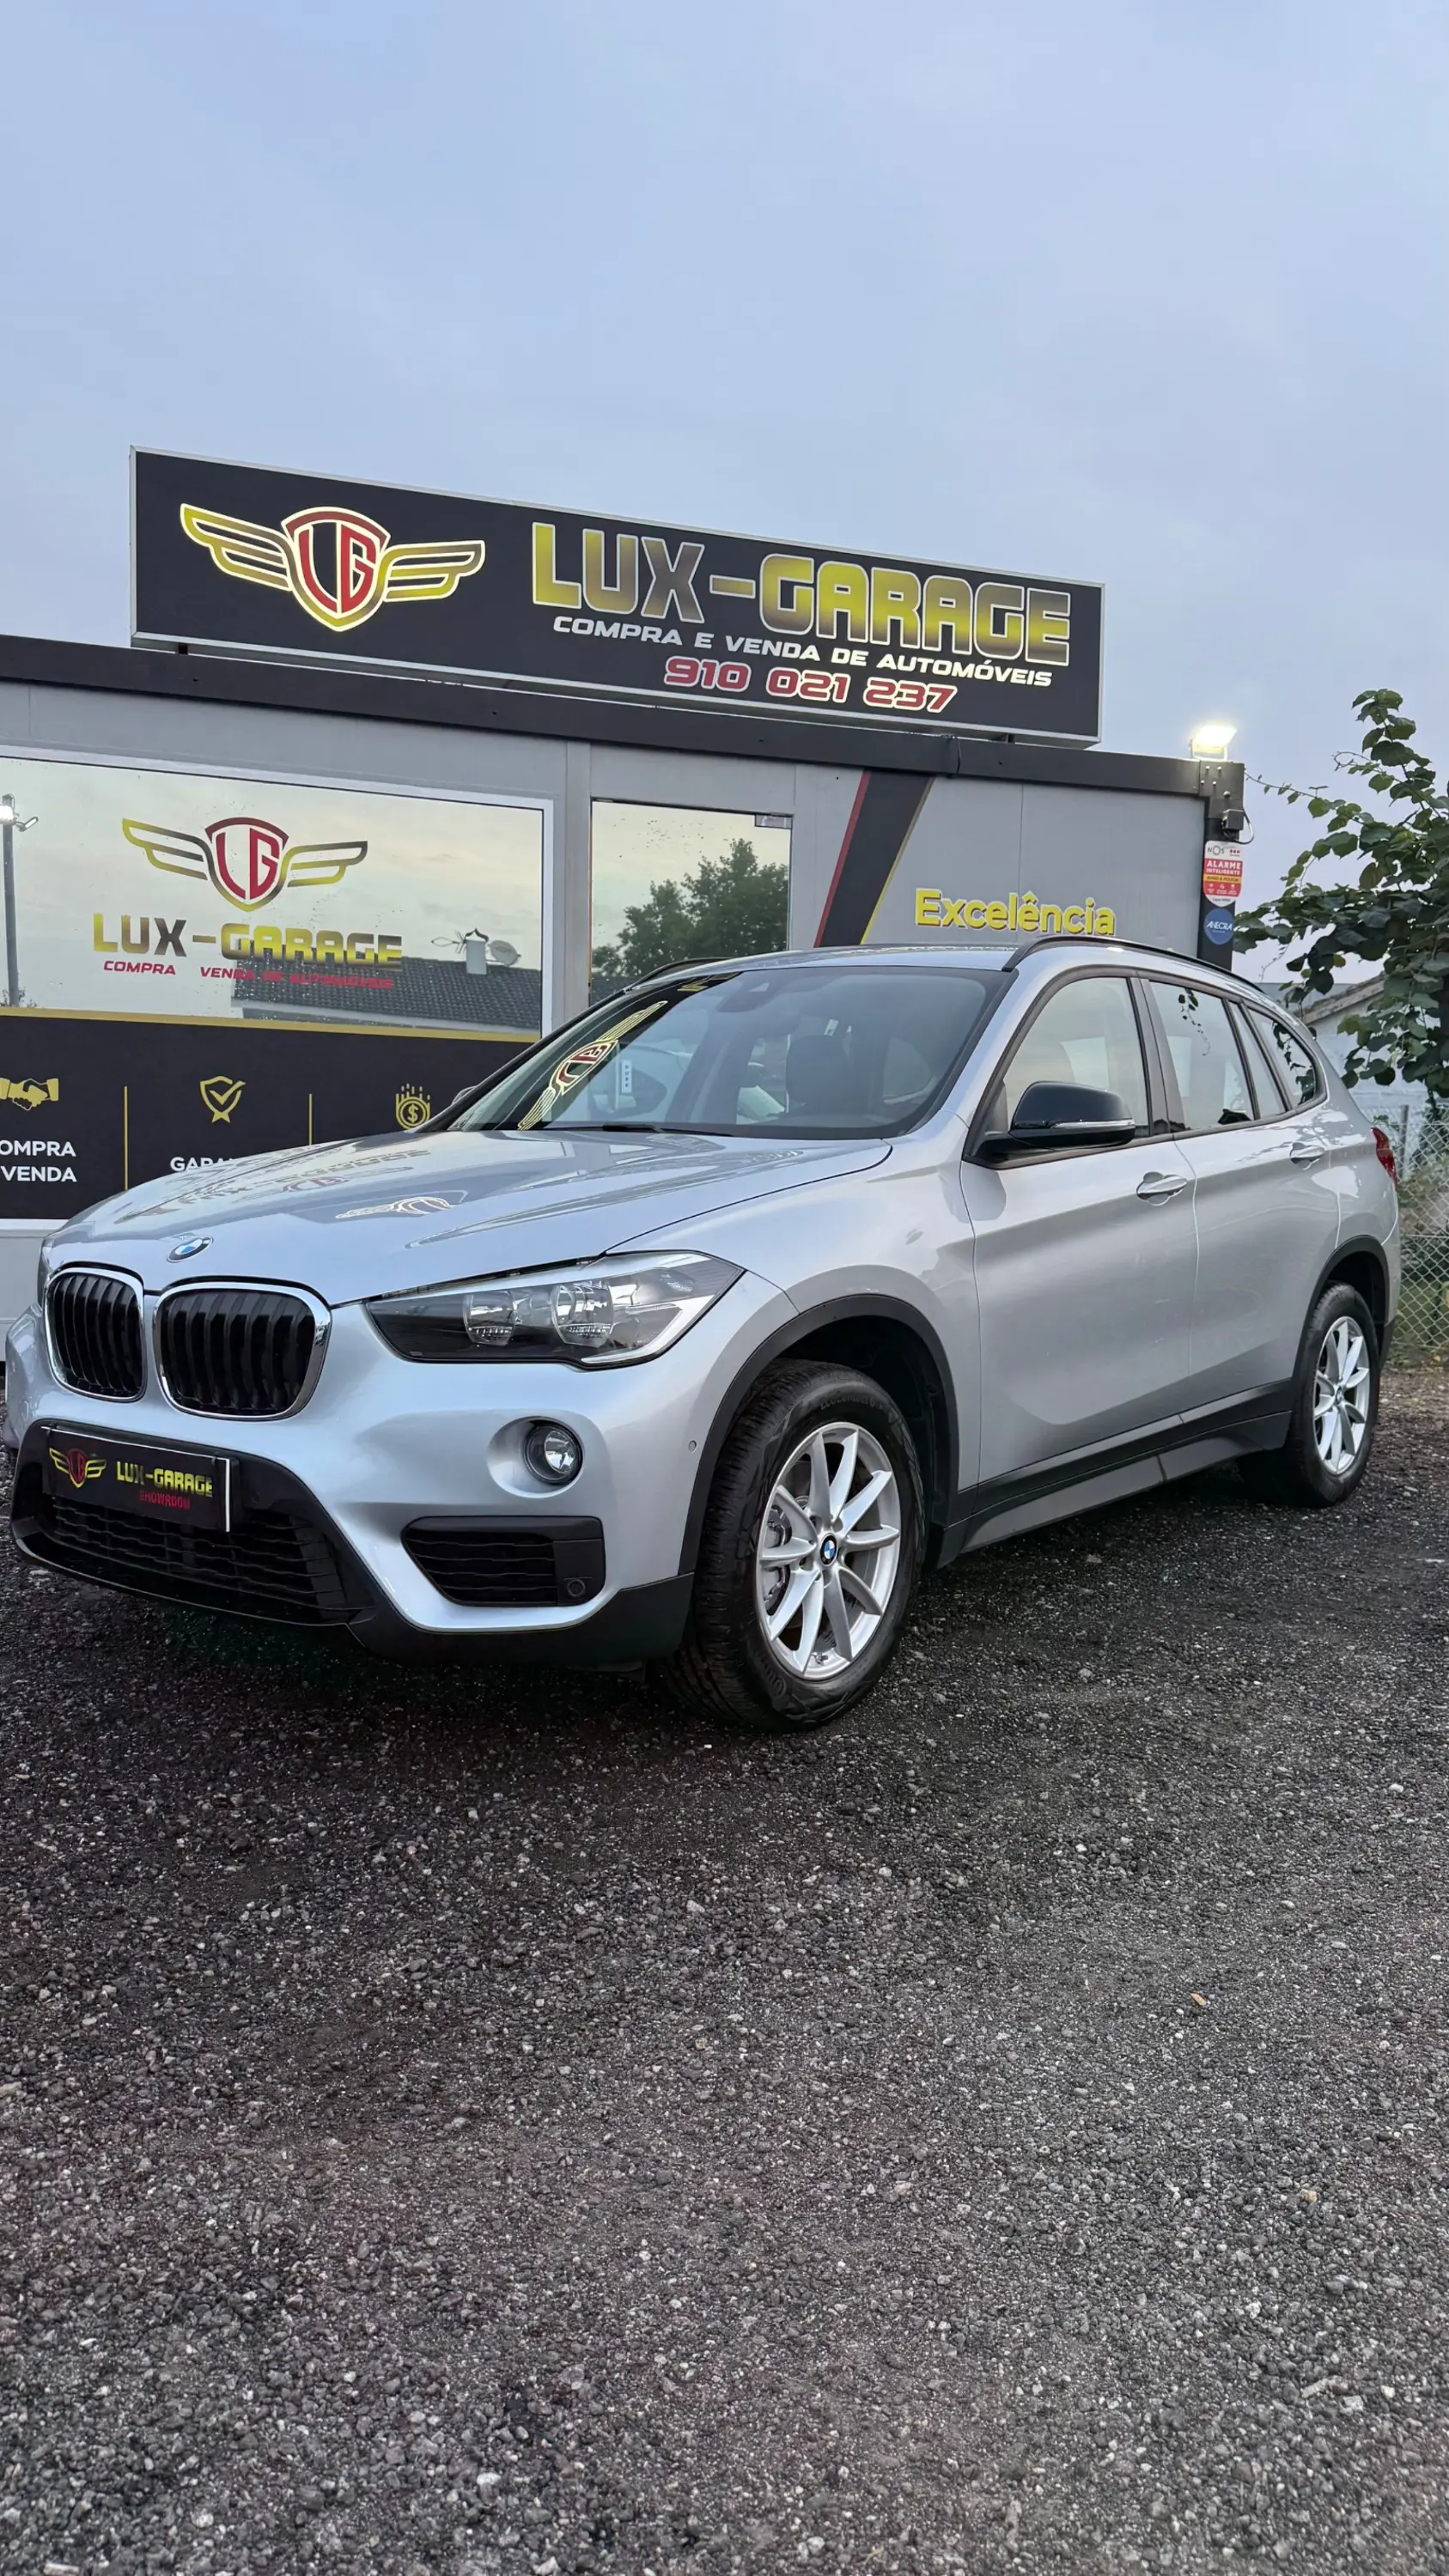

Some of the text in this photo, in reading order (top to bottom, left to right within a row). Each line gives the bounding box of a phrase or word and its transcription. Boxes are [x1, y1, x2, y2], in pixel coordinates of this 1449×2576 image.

[532, 522, 1071, 666] LUX-GARAGE
[553, 616, 1052, 687] COMPRA E VENDA DE AUTOMÓVEIS
[663, 655, 958, 714] 910 021 237
[1207, 860, 1241, 871] ALARME
[915, 887, 1116, 936] Excelência
[93, 913, 402, 972] LUX-GARAGE
[103, 960, 176, 975] COMPRA
[200, 966, 255, 981] VENDA
[0, 1139, 76, 1157] OMPRA
[0, 1165, 77, 1182] VENDA
[116, 1461, 213, 1498] LUX-GARAGE
[139, 1490, 191, 1510] SHOWROOM
